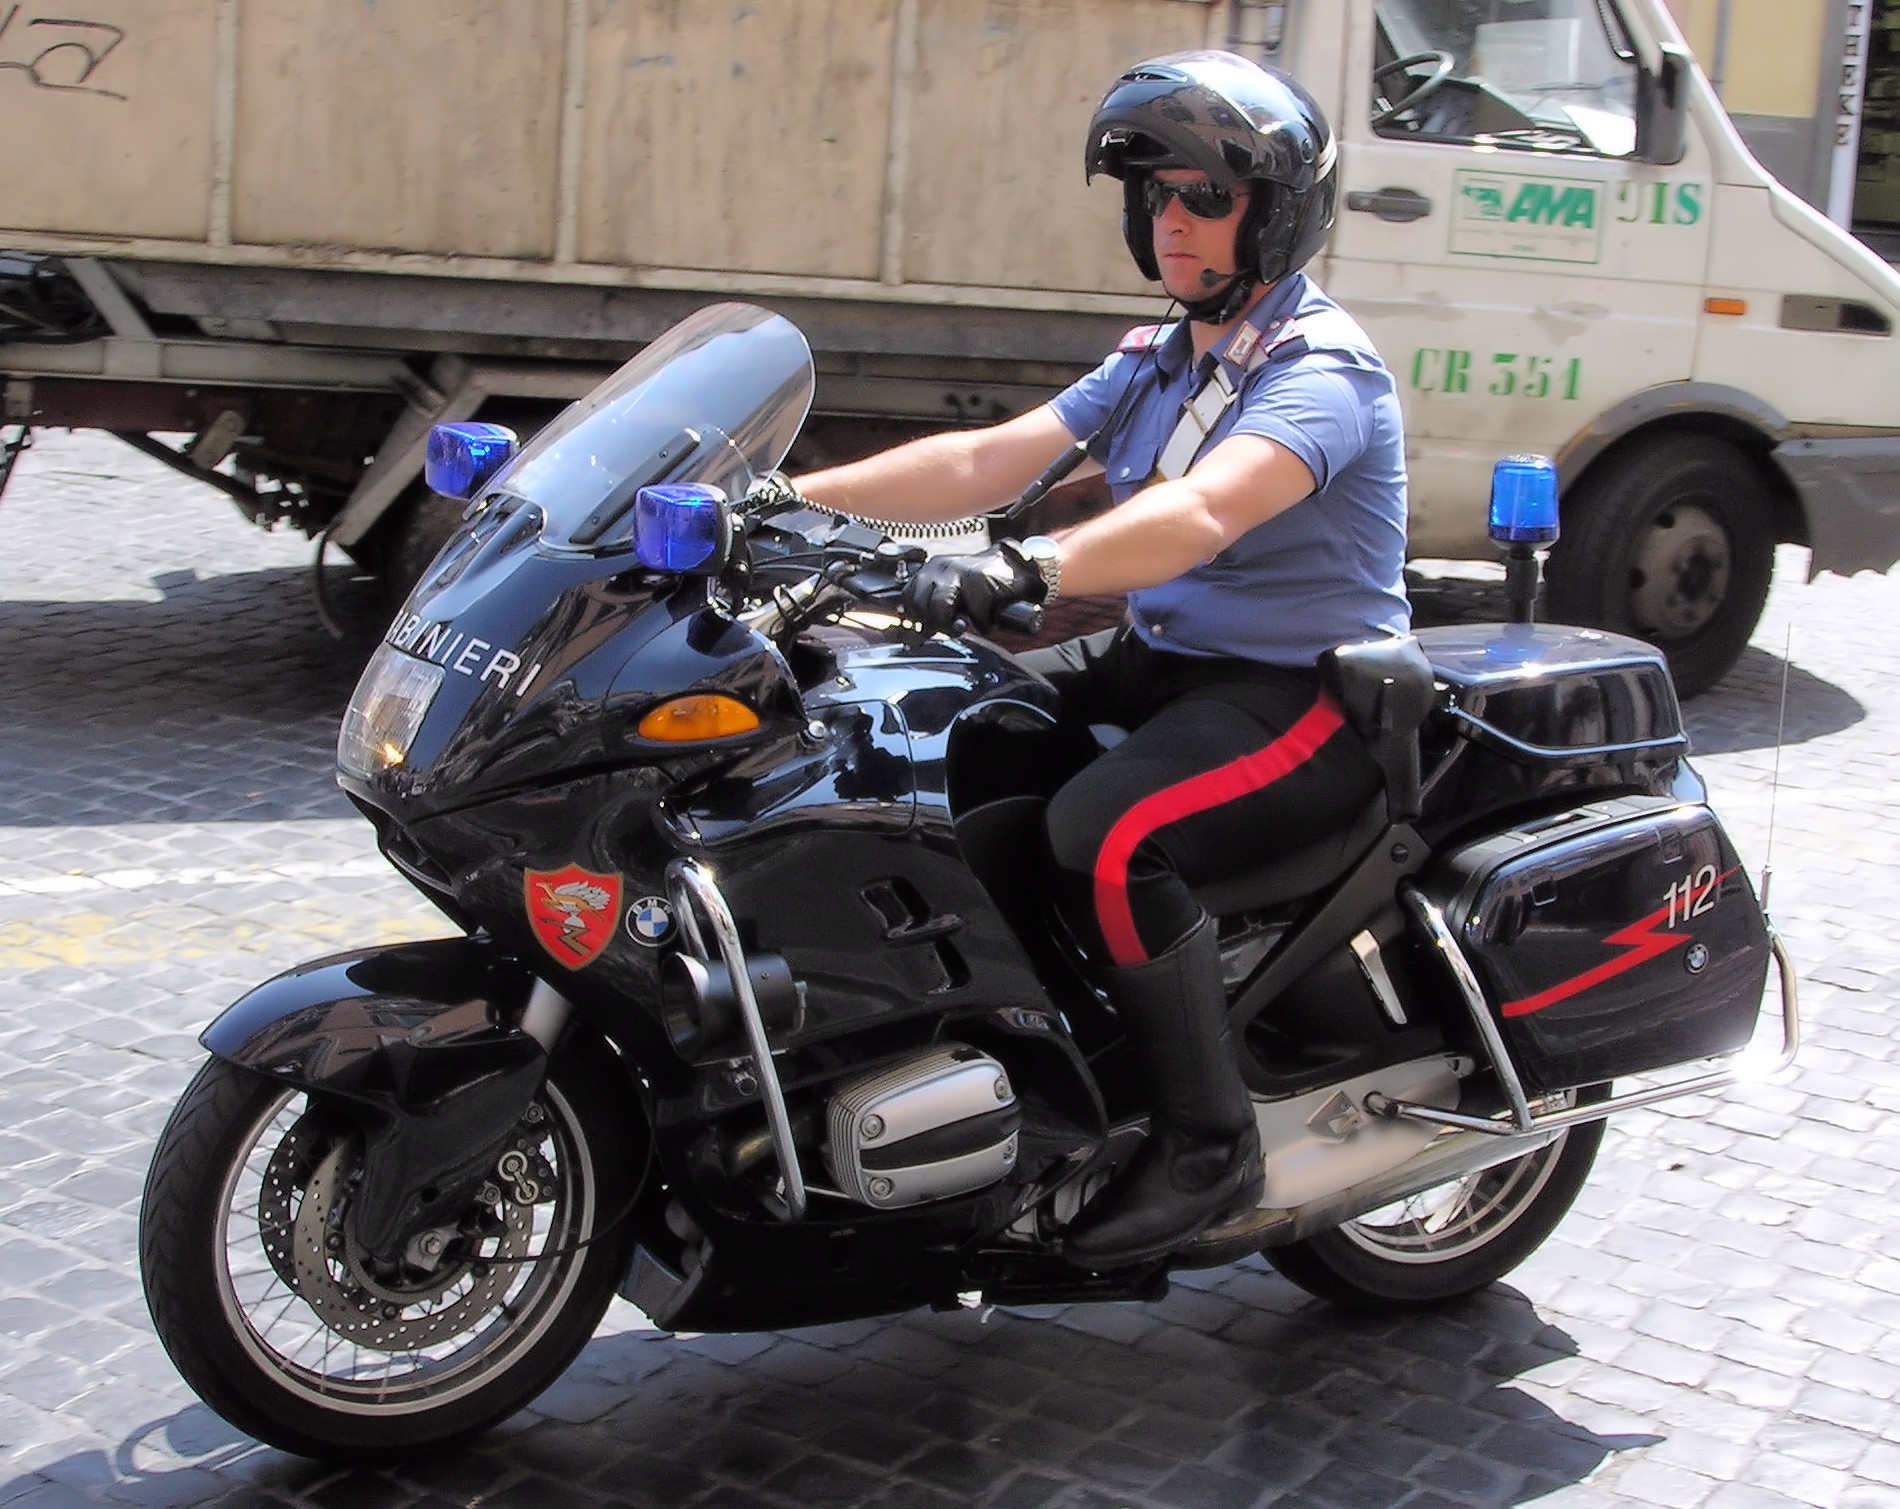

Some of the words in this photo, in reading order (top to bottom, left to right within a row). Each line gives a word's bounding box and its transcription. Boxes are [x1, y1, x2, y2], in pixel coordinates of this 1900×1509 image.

[1507, 183, 1596, 229] AMA
[1411, 348, 1472, 393] CR
[1662, 864, 1717, 929] 112
